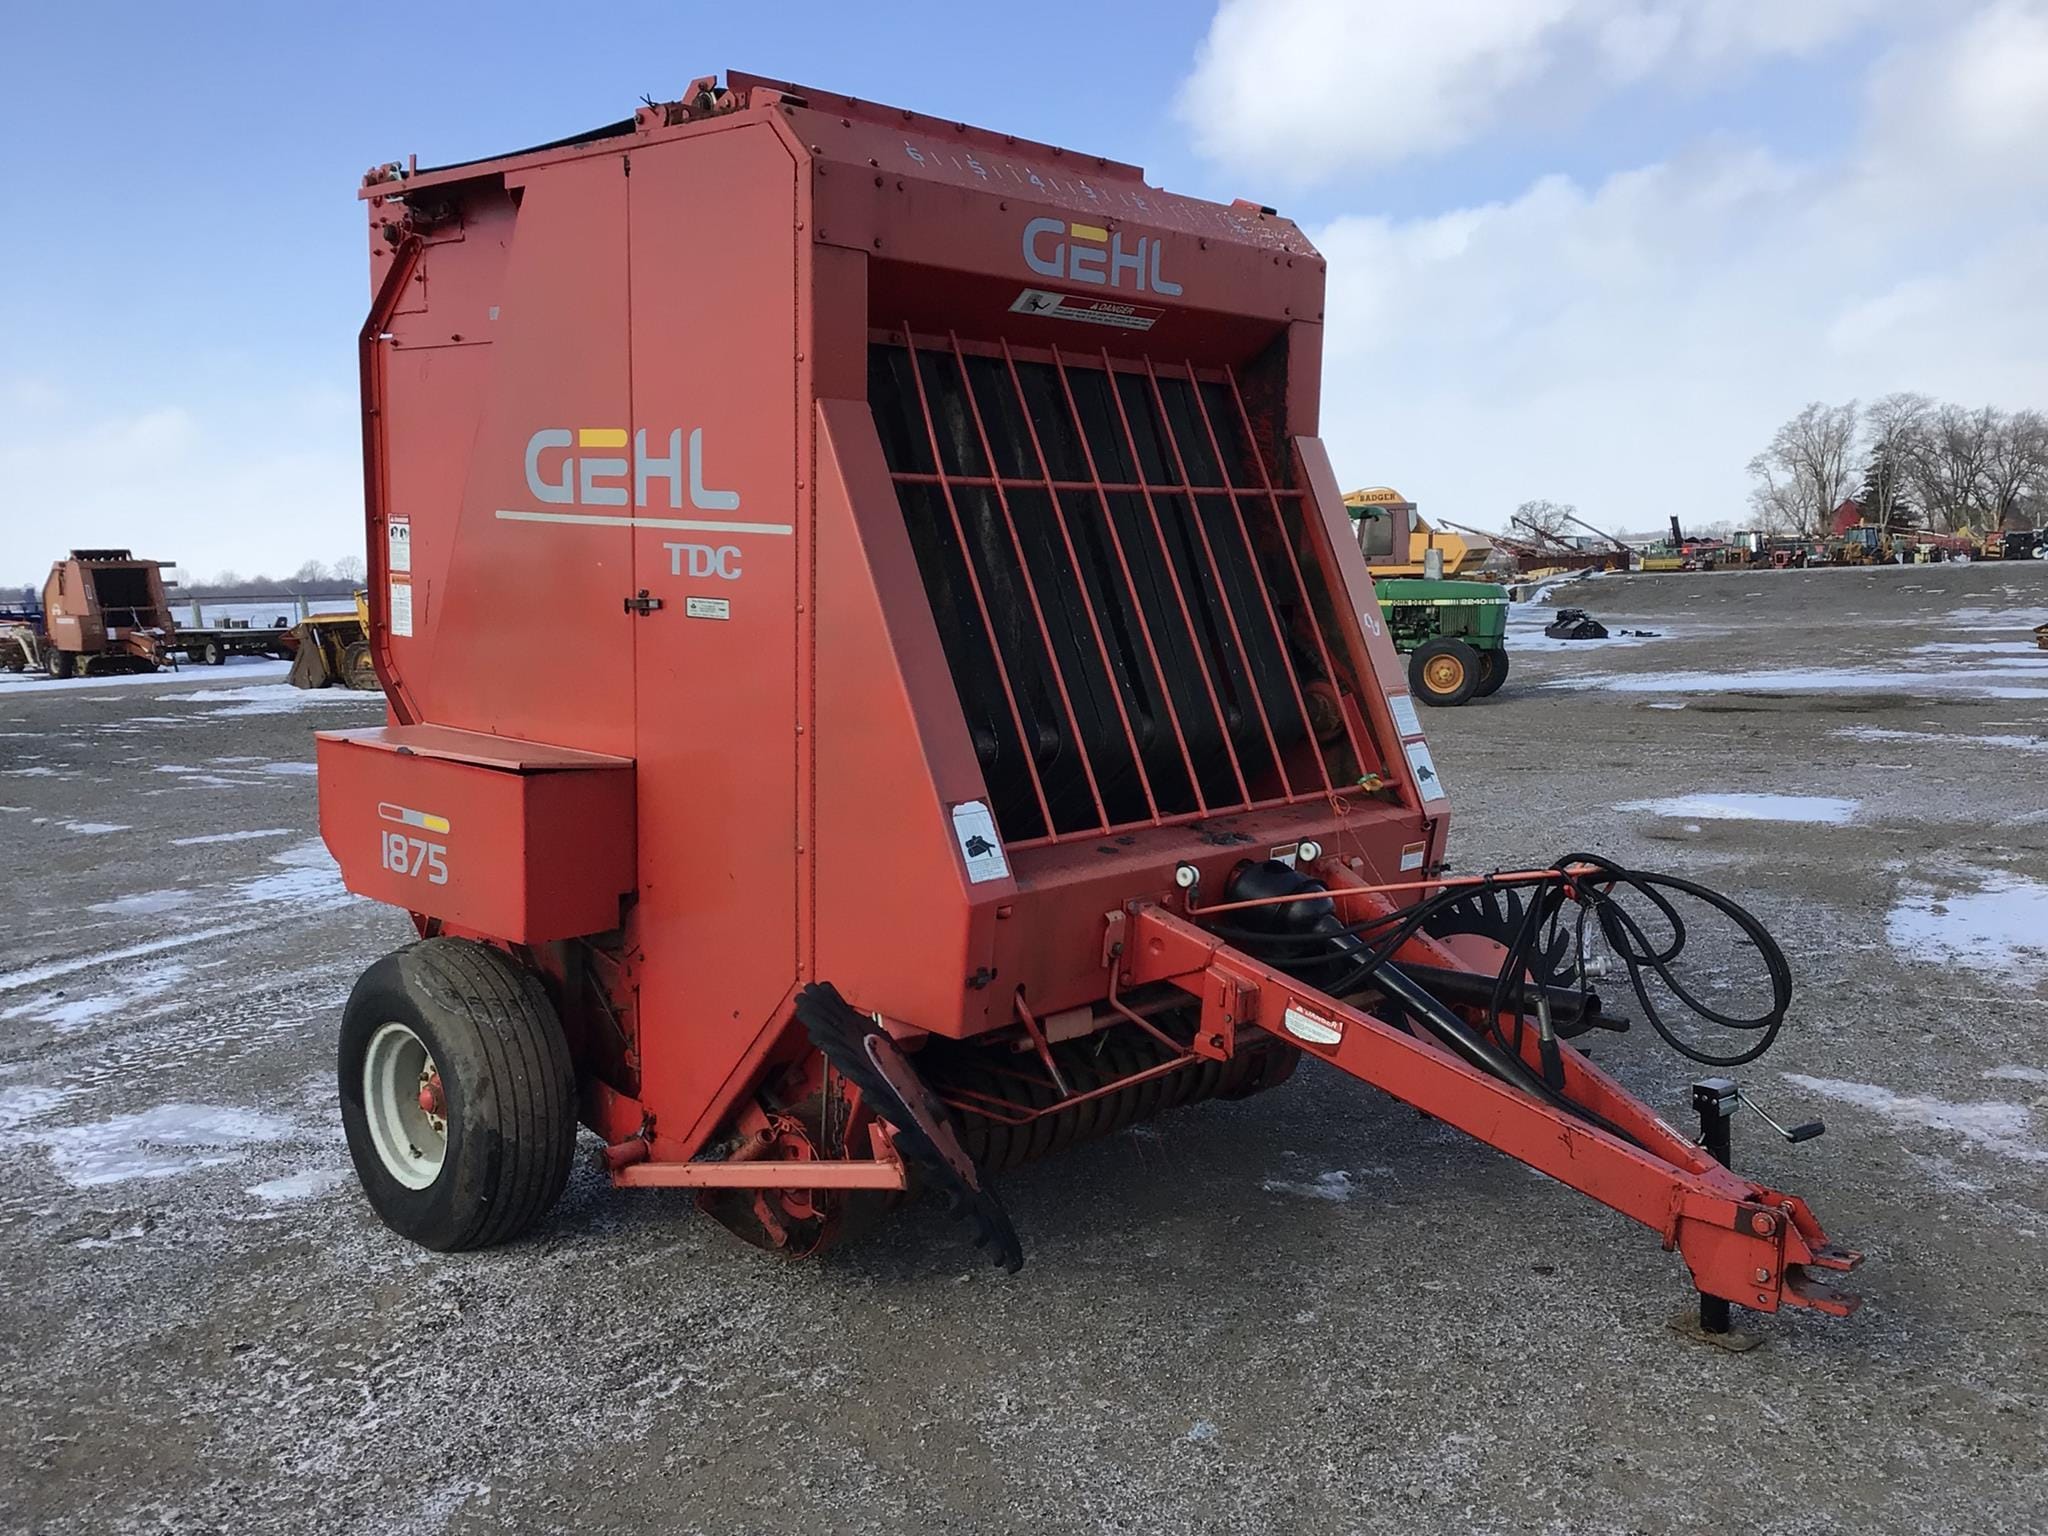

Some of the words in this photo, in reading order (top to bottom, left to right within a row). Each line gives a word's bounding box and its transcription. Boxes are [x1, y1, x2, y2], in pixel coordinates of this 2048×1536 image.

[967, 159, 987, 176] 5
[1022, 217, 1184, 297] GEHL
[1098, 302, 1136, 316] DANGER
[524, 427, 740, 511] GEHL
[1359, 493, 1396, 502] BADGER
[662, 542, 743, 580] TDC
[381, 830, 449, 885] 1875
